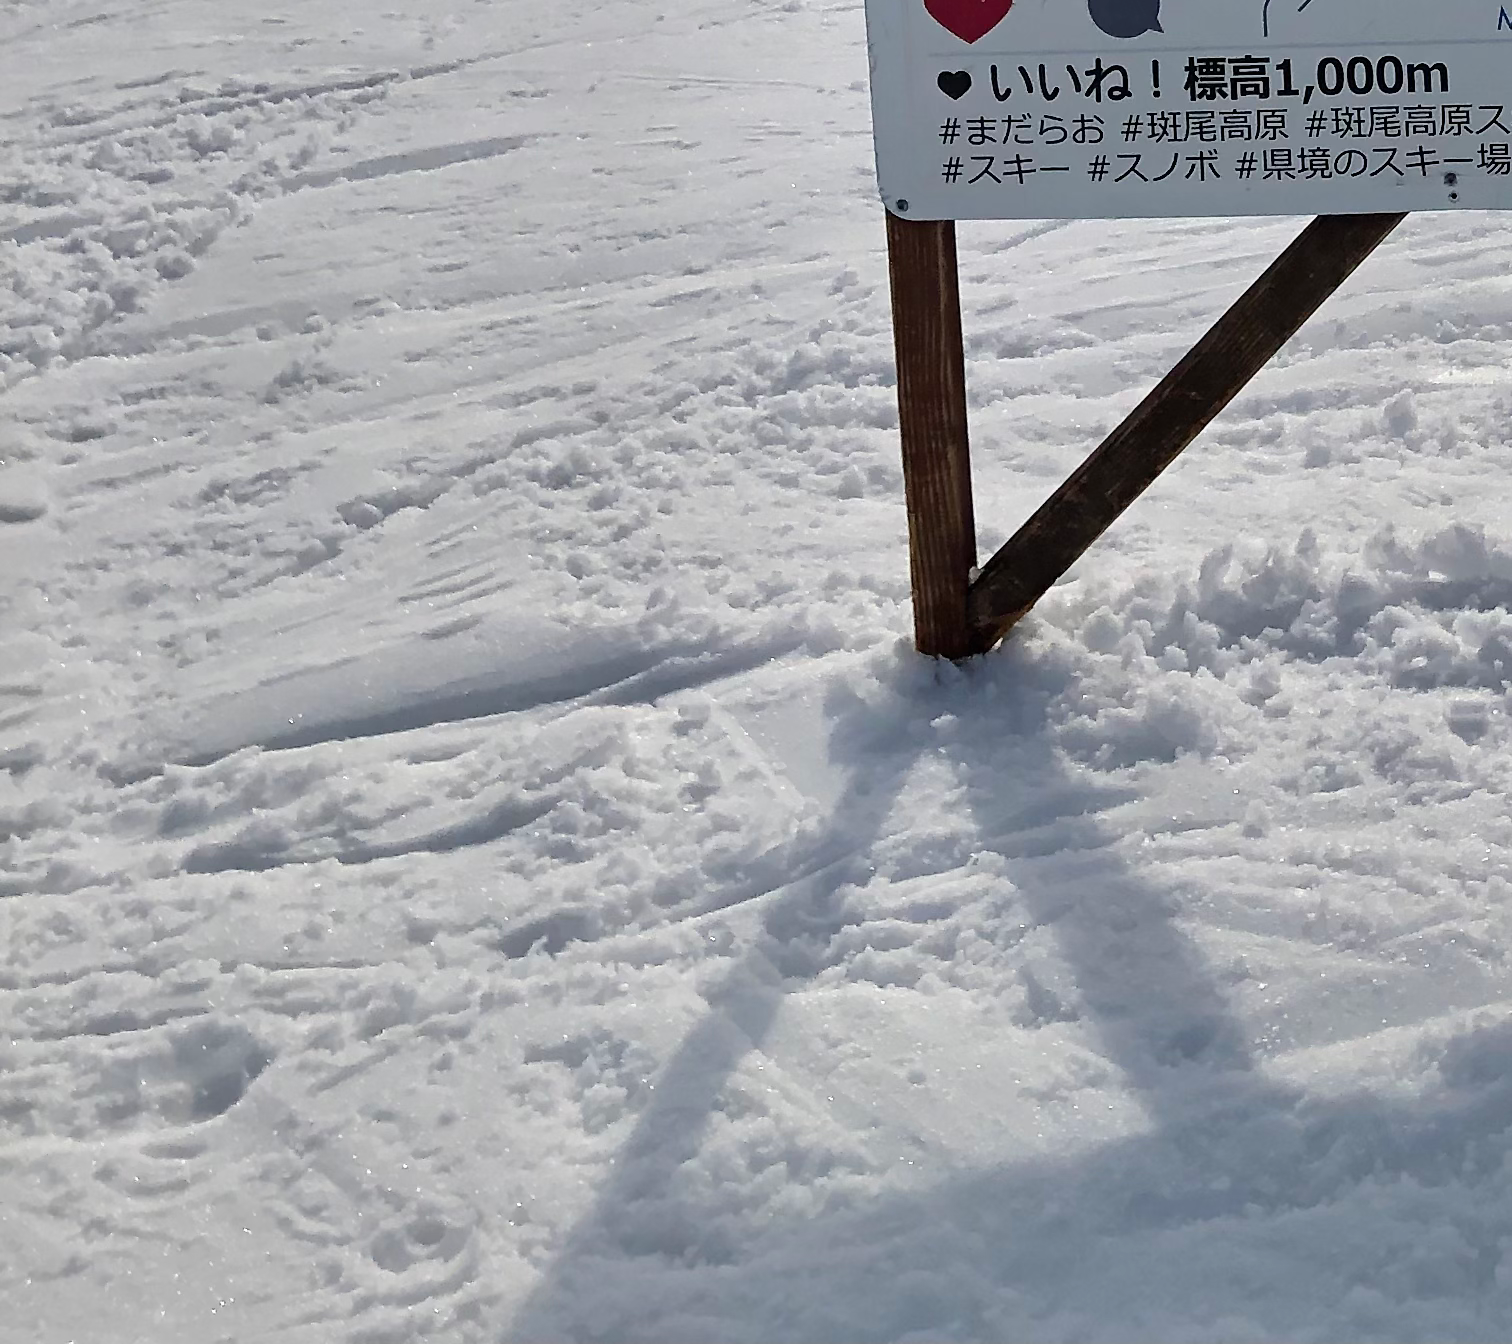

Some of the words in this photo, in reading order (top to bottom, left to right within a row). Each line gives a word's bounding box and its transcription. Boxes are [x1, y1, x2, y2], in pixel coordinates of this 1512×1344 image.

[1183, 55, 1450, 105] 標高1,000m
[938, 112, 1105, 146] #まだらお
[1121, 108, 1289, 144] #斑尾高原
[941, 153, 1071, 185] #スキー
[1087, 148, 1221, 183] #スノボ
[1235, 142, 1512, 181] #県境のスキー場
